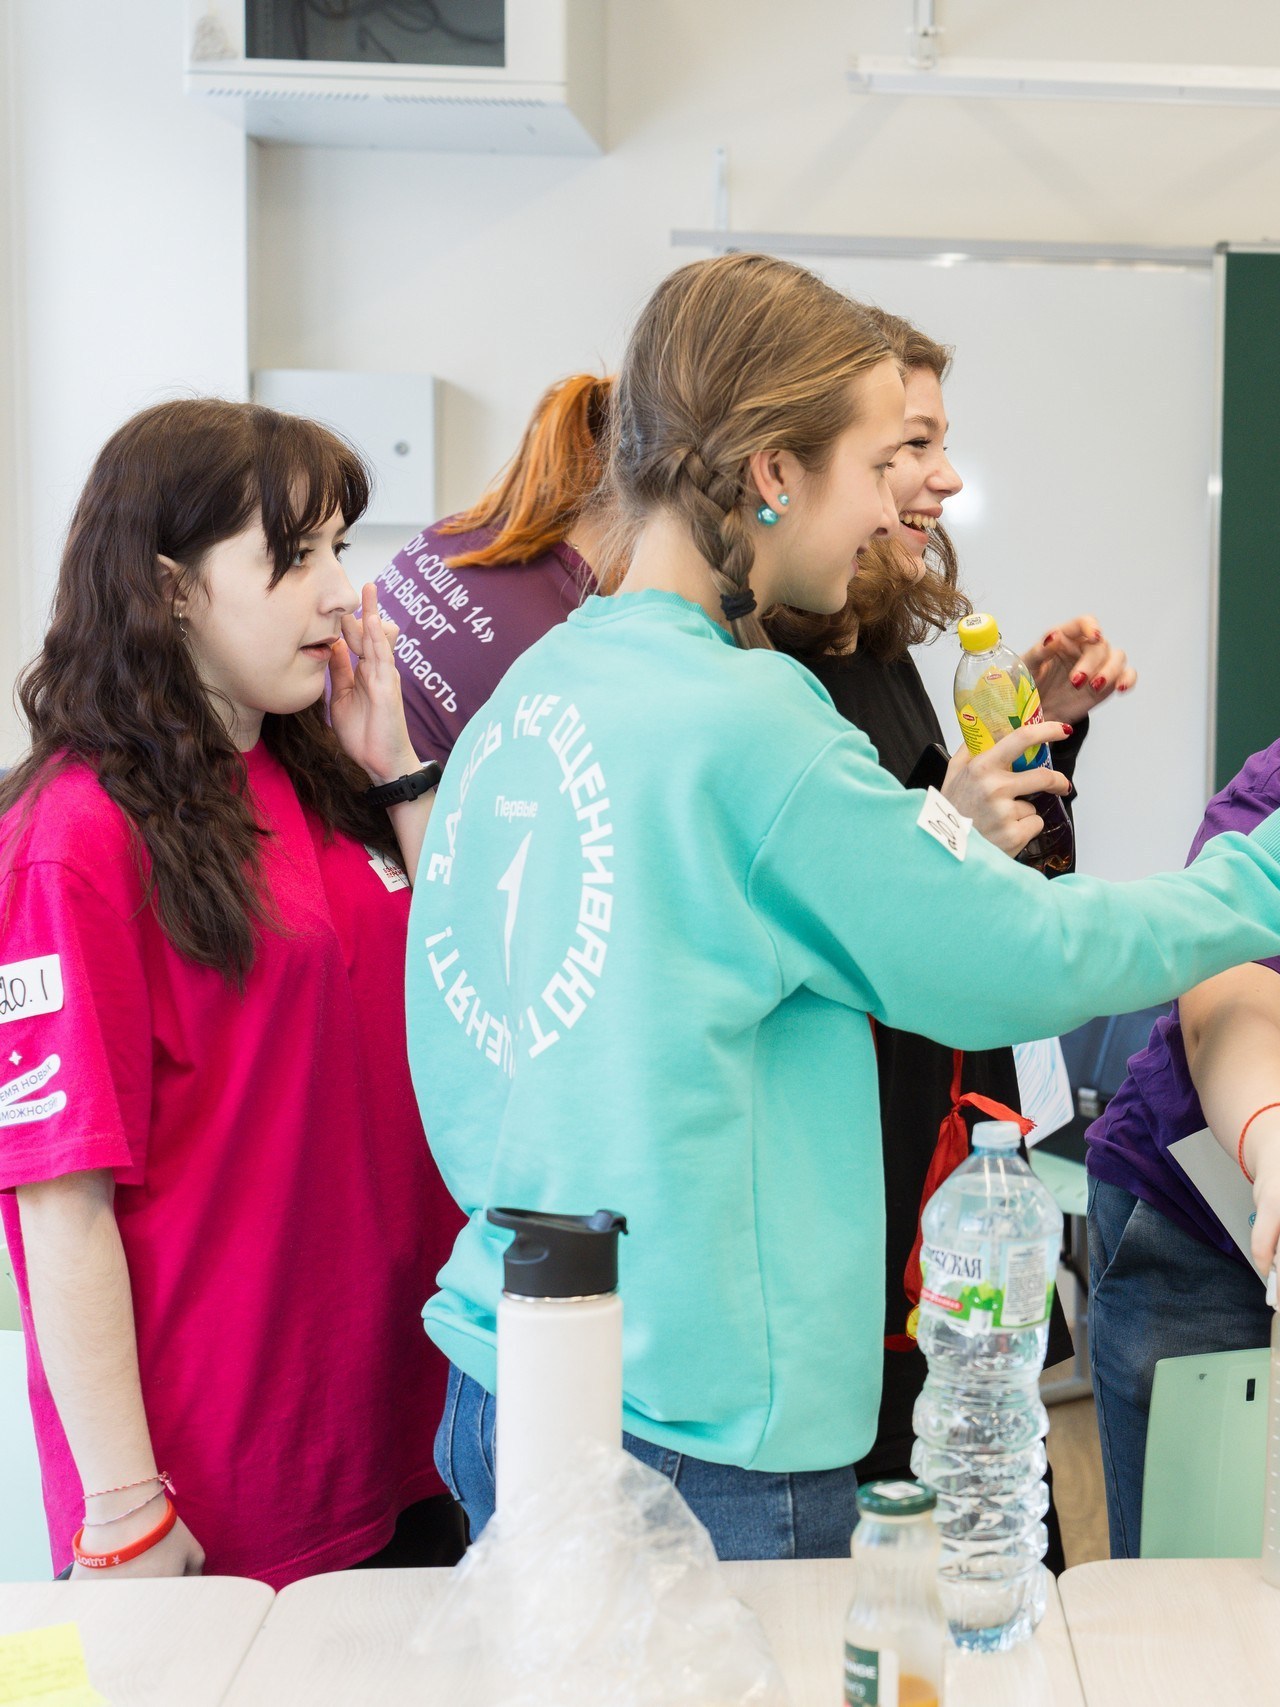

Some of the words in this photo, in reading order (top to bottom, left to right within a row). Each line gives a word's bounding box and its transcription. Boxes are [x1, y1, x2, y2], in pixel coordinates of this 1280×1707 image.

[394, 577, 456, 641] ВЫБОРГ
[415, 554, 457, 594] «СОШ
[444, 584, 469, 611] №
[463, 606, 495, 643] 14»
[394, 634, 458, 713] область
[513, 694, 561, 739] НЕ
[495, 795, 538, 823] Первые
